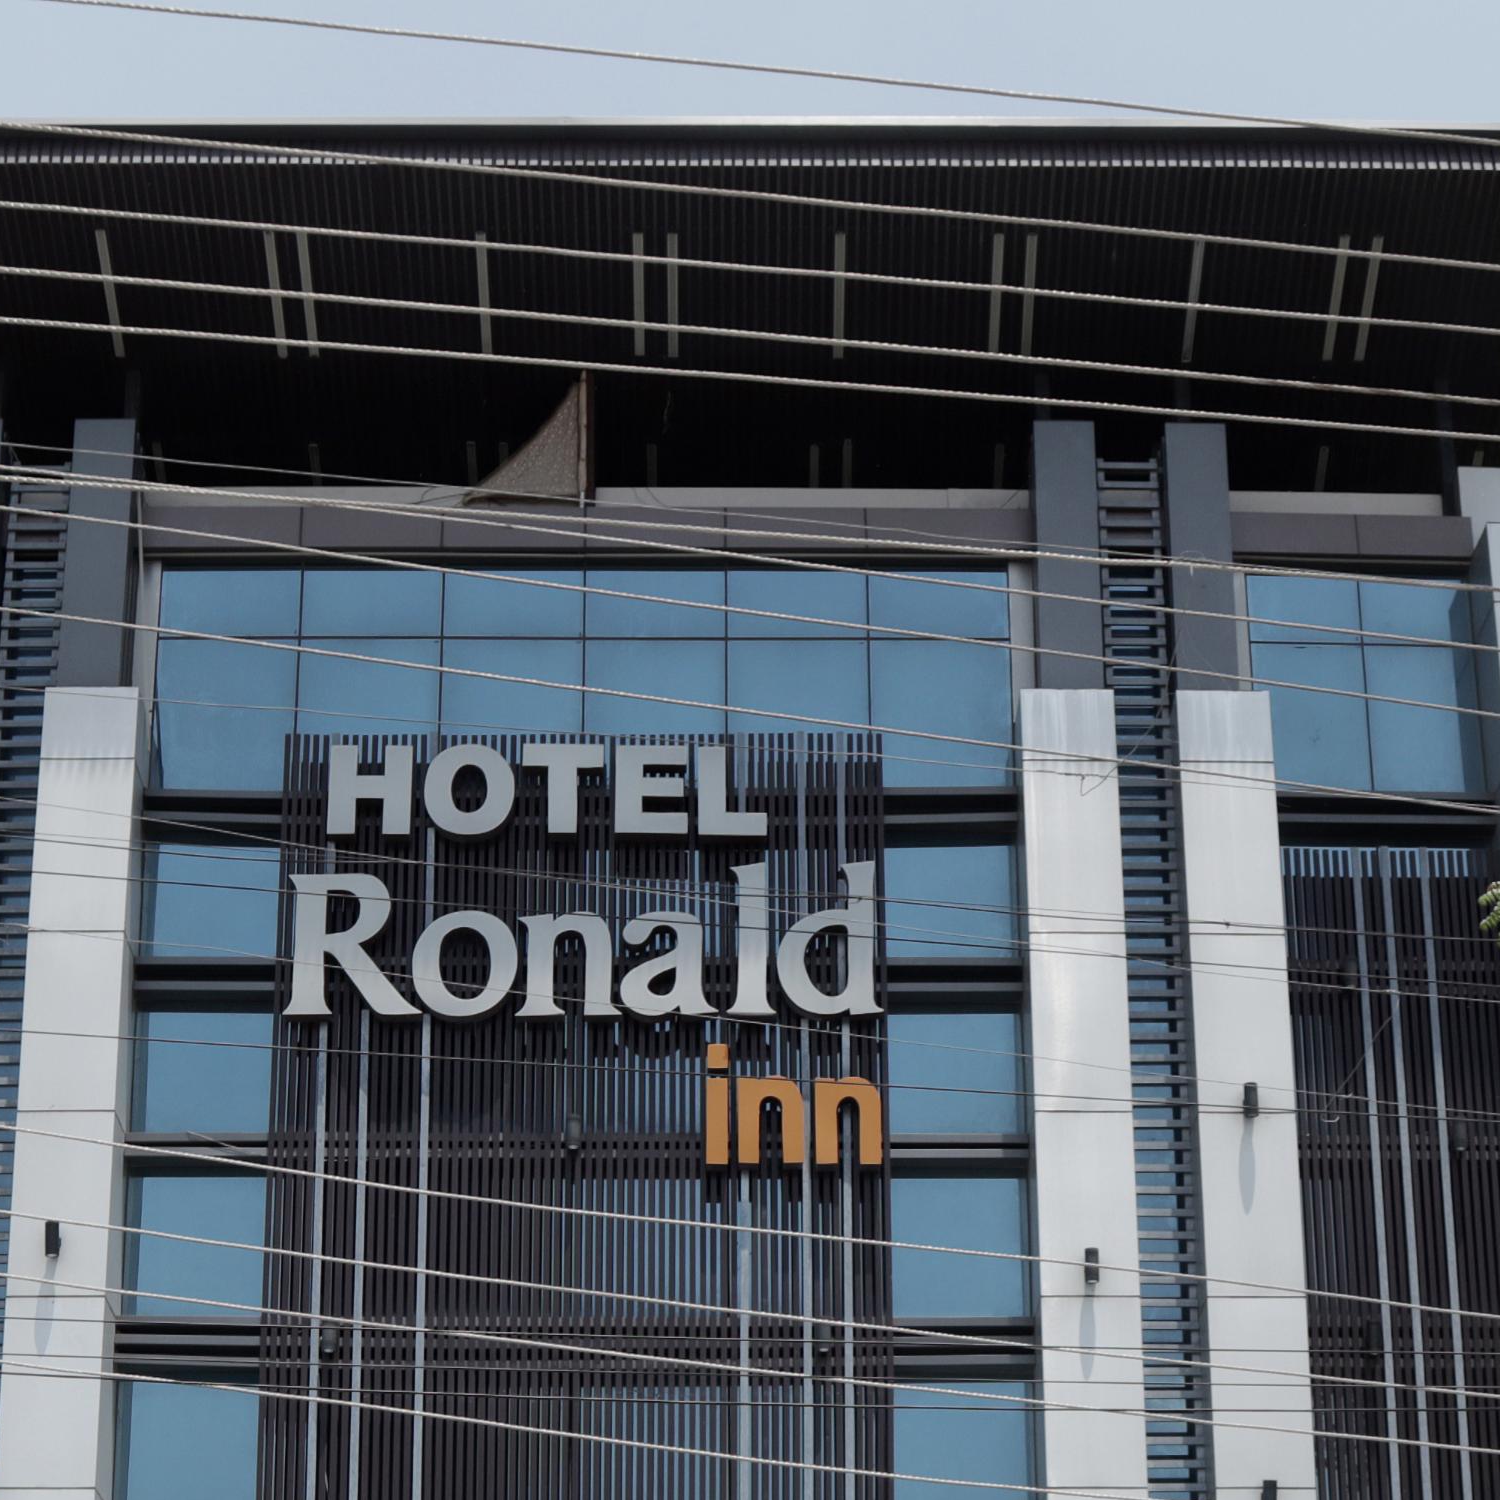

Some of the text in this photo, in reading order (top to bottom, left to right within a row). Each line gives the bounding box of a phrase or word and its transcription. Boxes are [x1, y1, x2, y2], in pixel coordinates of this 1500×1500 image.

[326, 742, 769, 840] HOTEL
[281, 858, 886, 1021] Ronald
[705, 1042, 883, 1168] inn
